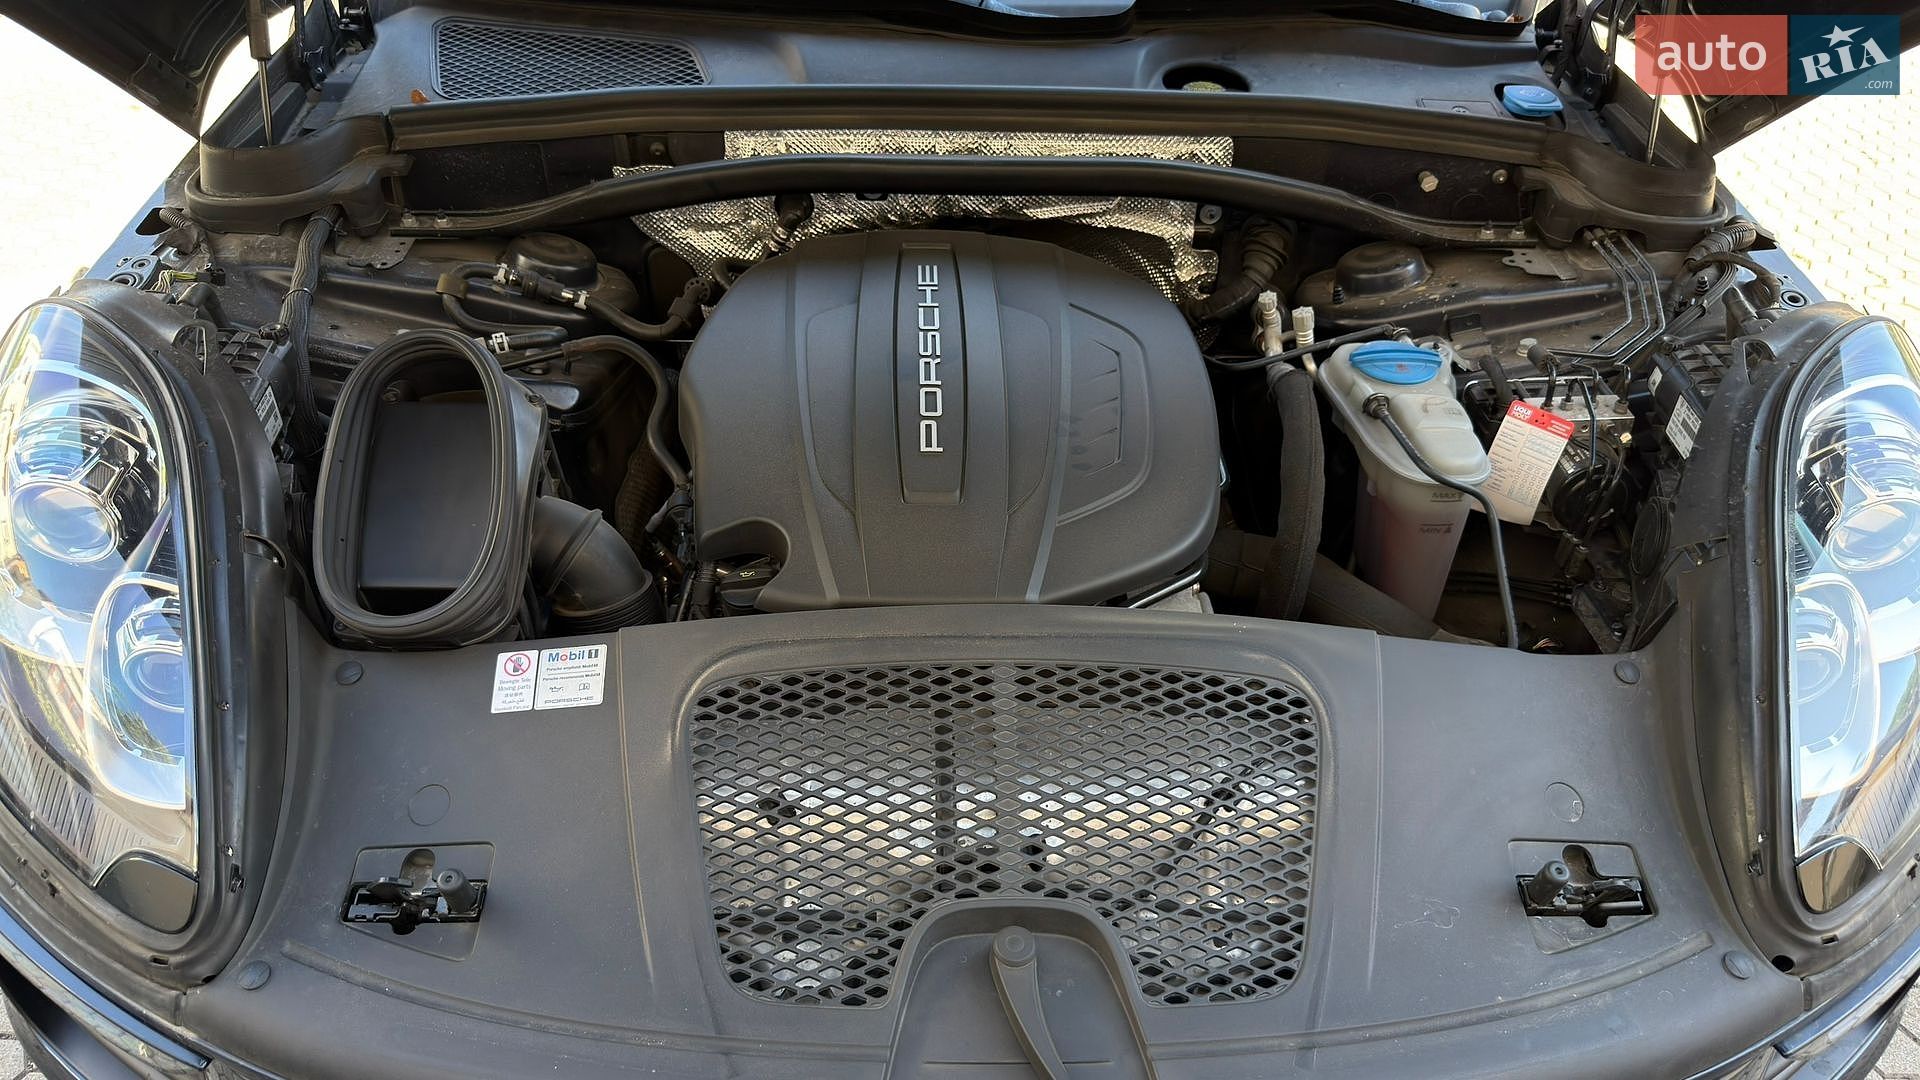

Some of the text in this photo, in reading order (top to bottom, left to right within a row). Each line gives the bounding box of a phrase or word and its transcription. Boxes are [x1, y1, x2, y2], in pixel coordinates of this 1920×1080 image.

[917, 264, 944, 452] PORSCHE
[547, 650, 585, 663] Mobil
[544, 695, 594, 704] PORSCHE
